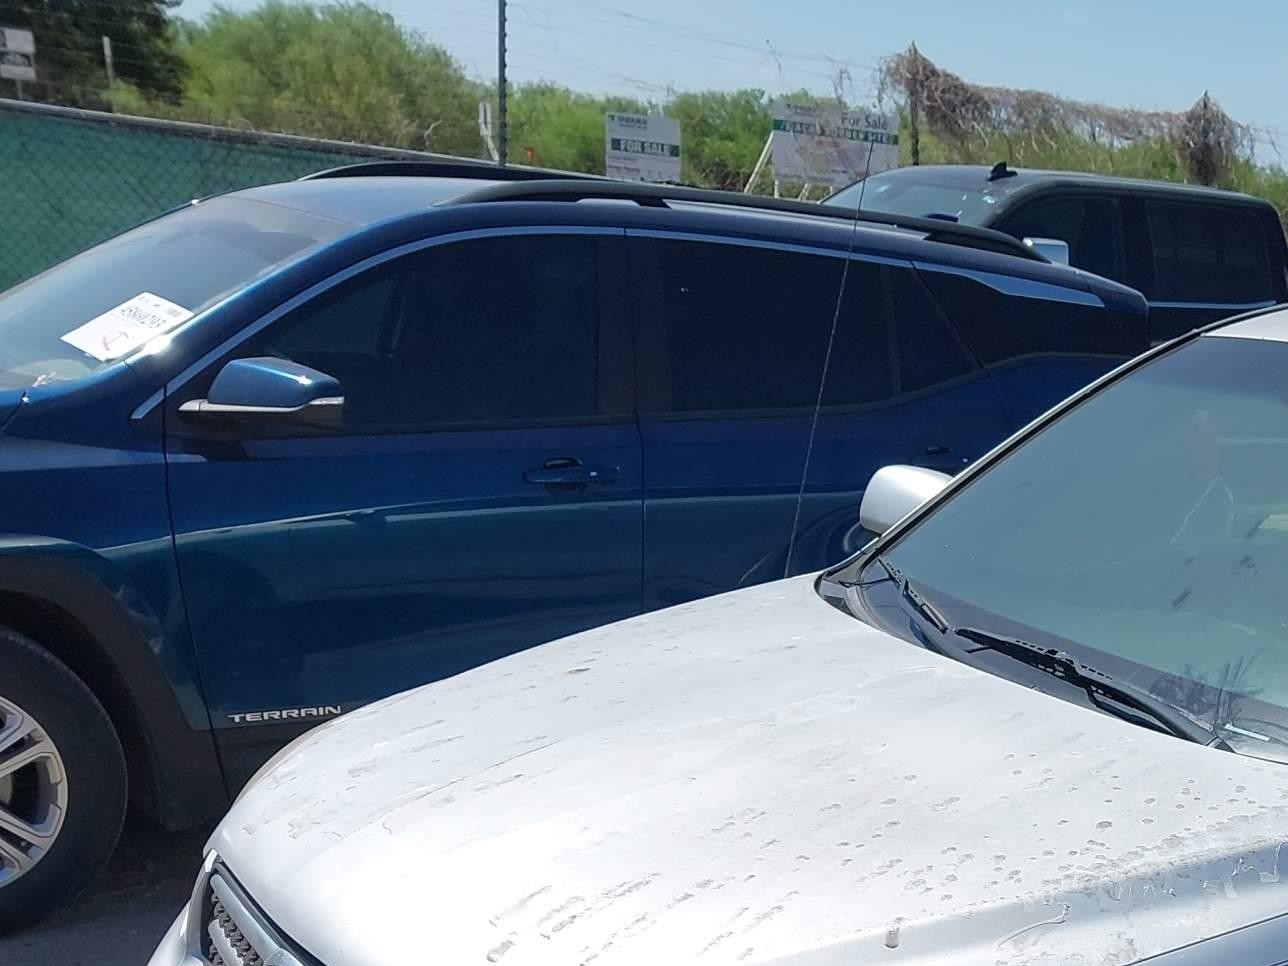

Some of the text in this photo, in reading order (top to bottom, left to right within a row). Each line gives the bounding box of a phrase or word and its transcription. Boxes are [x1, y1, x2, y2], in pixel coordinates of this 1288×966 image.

[840, 111, 888, 130] For Sale
[620, 139, 671, 157] FOR SALE
[227, 705, 341, 723] TERRAIN
